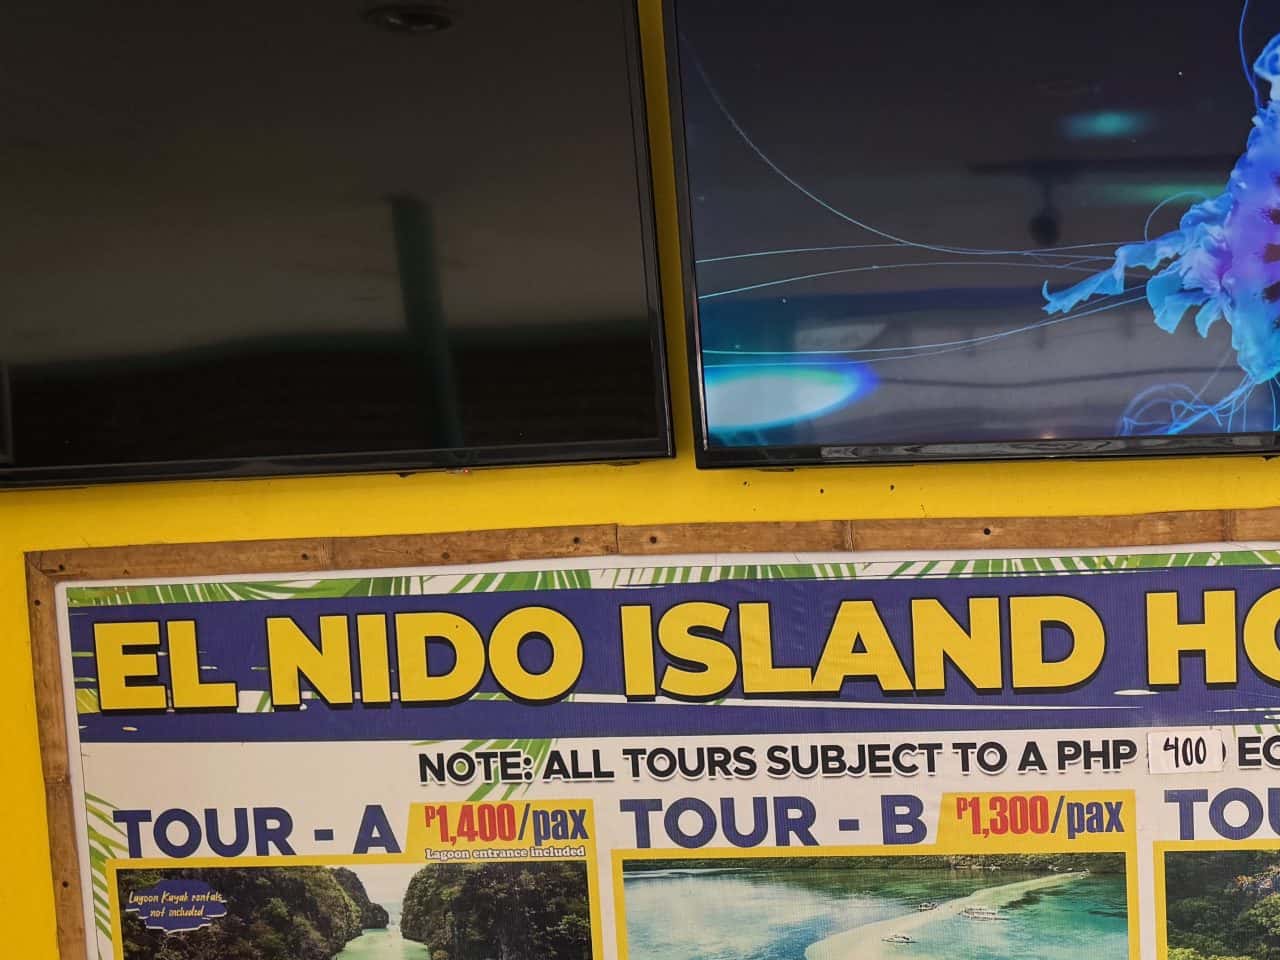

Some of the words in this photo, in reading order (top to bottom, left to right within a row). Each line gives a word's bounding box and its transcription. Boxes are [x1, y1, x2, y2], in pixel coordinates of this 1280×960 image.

[94, 620, 238, 712] EL
[265, 605, 585, 710] NIDO
[620, 594, 1107, 702] ISLAND
[419, 749, 534, 783] NOTE:
[542, 749, 615, 780] ALL
[622, 745, 758, 778] TOURS
[767, 742, 943, 777] SUBJECT
[952, 741, 1008, 774] TO
[1017, 741, 1048, 772] A
[1057, 739, 1138, 772] PHP
[1163, 736, 1206, 768] 400
[112, 807, 295, 858] TOUR
[354, 805, 401, 855] A
[620, 797, 816, 849] TOUR
[882, 793, 928, 845] B
[425, 848, 471, 861] Lagoon
[472, 847, 528, 858] entrance
[530, 845, 586, 857] included
[128, 890, 159, 905] Lagoon
[161, 890, 188, 904] Kayak
[191, 890, 223, 902] rentals
[150, 906, 165, 917] not
[168, 905, 205, 917] included
